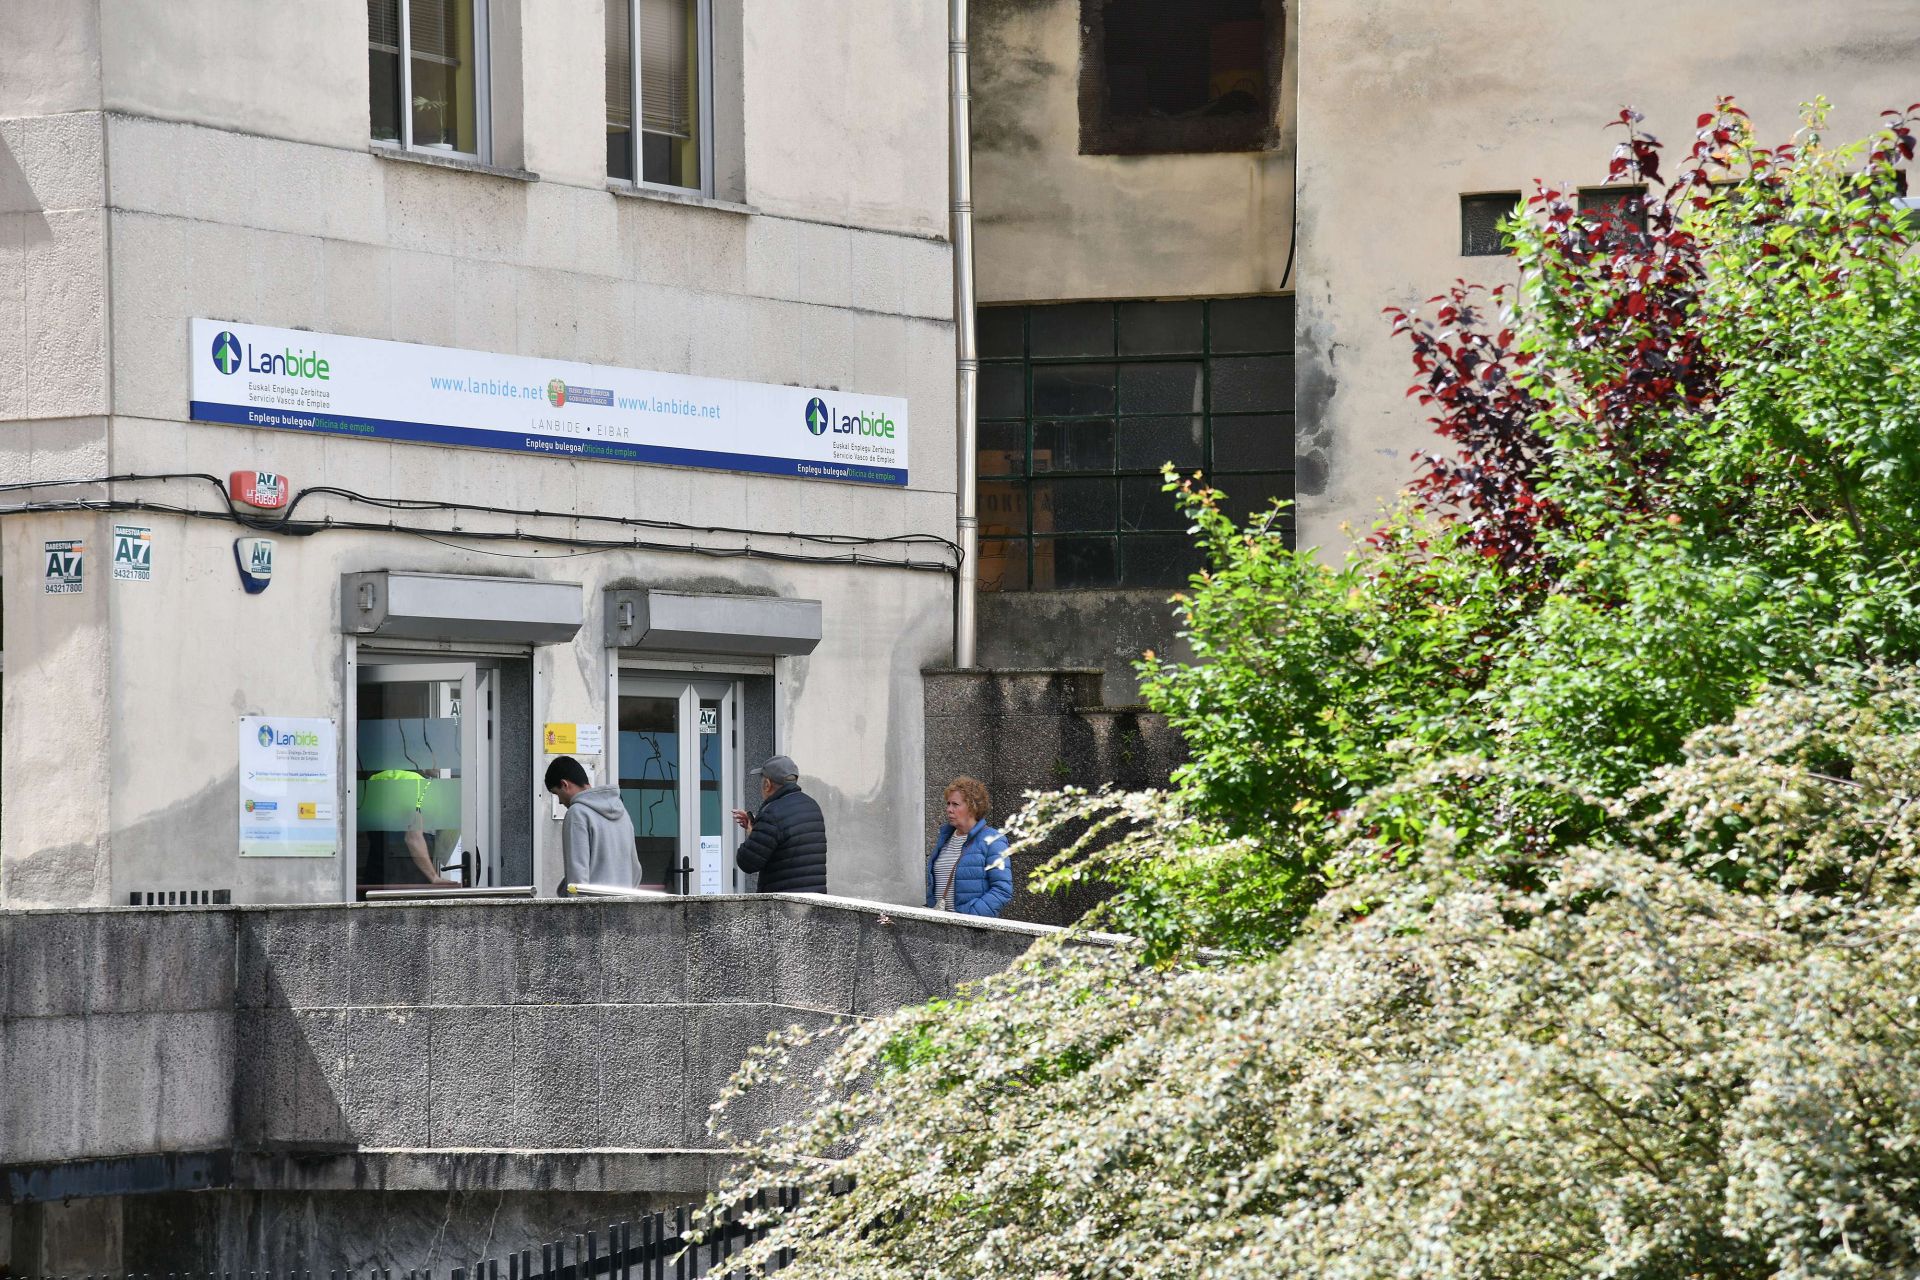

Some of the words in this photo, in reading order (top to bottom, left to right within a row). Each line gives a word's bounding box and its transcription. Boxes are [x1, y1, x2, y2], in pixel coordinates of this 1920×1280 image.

[249, 343, 330, 381] Lanbide
[248, 382, 271, 392] Euskal
[272, 384, 299, 396] Enplegu
[300, 387, 330, 398] Zerbitzua
[430, 376, 544, 401] www.lanbide.net
[249, 393, 275, 404] Servicio
[276, 396, 295, 406] Vasco
[297, 397, 305, 407] de
[306, 399, 330, 409] Empleo
[618, 396, 722, 420] www.lanbide.net
[248, 411, 280, 425] Enplegu
[340, 421, 348, 430] de
[349, 423, 375, 433] empleo
[531, 418, 581, 434] LANBIDE
[597, 424, 630, 439] EIBAR
[833, 407, 895, 438] Lanbide
[525, 438, 553, 451] Enplegu
[605, 447, 613, 455] de
[614, 448, 637, 457] empleo
[833, 441, 850, 450] Euskal
[850, 443, 871, 453] Enplegu
[872, 445, 895, 455] Zerbitzua
[833, 451, 853, 460] Servicio
[853, 453, 868, 462] Vasco
[877, 456, 895, 464] Empleo
[257, 472, 277, 487] A7
[797, 463, 822, 475] Enplegu
[867, 471, 875, 479] de
[875, 472, 896, 481] empleo
[254, 494, 277, 505] FUEGO
[114, 537, 151, 564] A7
[251, 542, 272, 565] A7
[46, 552, 83, 577] A7
[113, 570, 150, 580] 943217800
[45, 584, 83, 593] 943217800
[700, 711, 716, 725] A7
[276, 730, 319, 746] Lanbide
